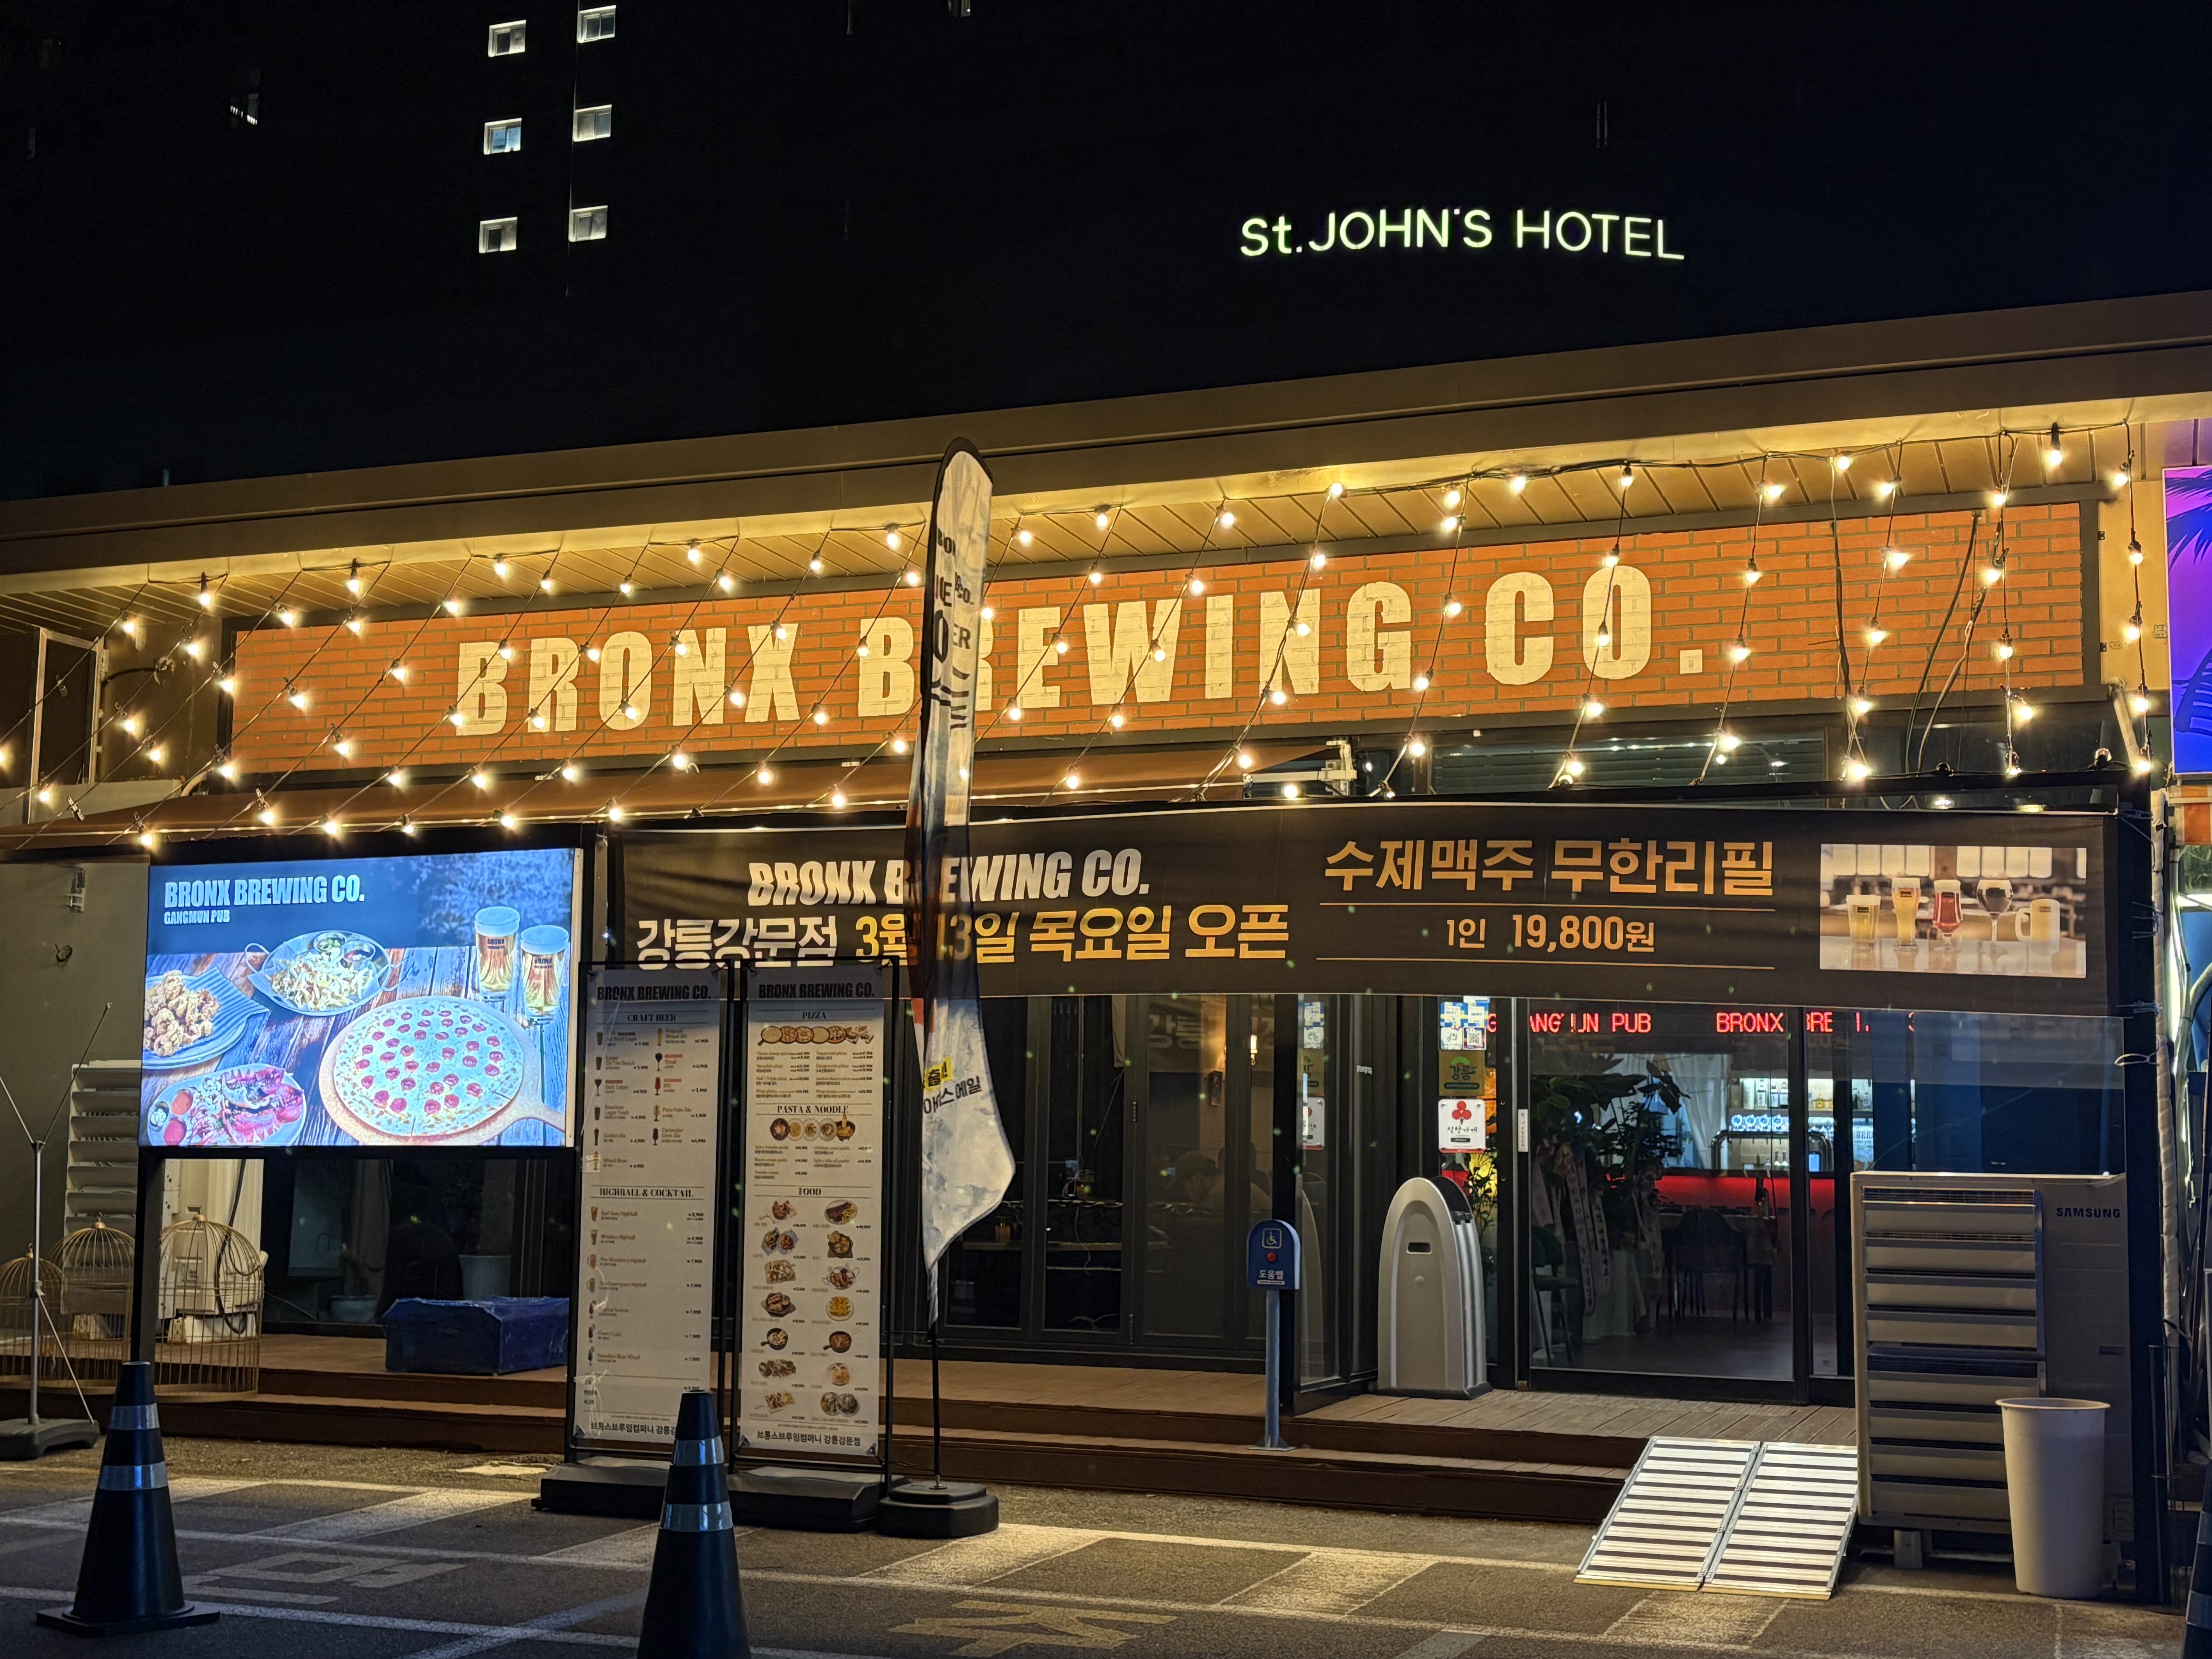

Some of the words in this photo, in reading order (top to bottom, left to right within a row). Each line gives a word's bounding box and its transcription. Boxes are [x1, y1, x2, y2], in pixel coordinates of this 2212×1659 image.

[1516, 209, 1685, 260] HOTEL
[456, 623, 800, 737] BRONX
[1486, 565, 1703, 685] CO.
[1325, 839, 1534, 891] 수제맥주
[1551, 838, 1774, 896] 무한리필
[748, 860, 876, 907] BRONX
[1081, 849, 1150, 897] CO.
[165, 879, 230, 908] BRONX
[234, 876, 327, 905] BREWING
[331, 874, 365, 903] CO.
[164, 910, 210, 925] GANGMUN
[211, 909, 230, 923] PUB
[637, 915, 837, 970] 강릉강문점
[855, 914, 918, 966] 3월
[936, 912, 1020, 963] 13일
[1028, 906, 1170, 962] 목요일
[1184, 904, 1289, 960] 오픈
[1447, 918, 1486, 949] 1인
[1512, 914, 1655, 953] 19,800원
[597, 986, 635, 1001] BRONX
[637, 985, 690, 1000] BREWING
[692, 985, 711, 1000] CO.
[759, 984, 797, 998] BRONX
[799, 983, 853, 998] BREWING
[855, 982, 875, 998] CO.
[627, 1014, 654, 1022] CRAFT
[656, 1013, 676, 1022] BEER
[1612, 1013, 1652, 1033] PUB
[1716, 1012, 1784, 1033] BRONX
[777, 1105, 804, 1114] PASTA
[814, 1105, 849, 1114] NOODLE
[599, 1188, 641, 1197] HIGHBALL
[642, 1188, 648, 1197] &
[650, 1188, 694, 1197] COCKTAIL
[799, 1187, 822, 1195] FOOD
[2056, 1207, 2120, 1218] SAMSUNG
[1259, 1270, 1283, 1280] 도움벨
[757, 1430, 822, 1444] 브롱스브루잉컴퍼니
[824, 1435, 860, 1446] 강릉강문점
